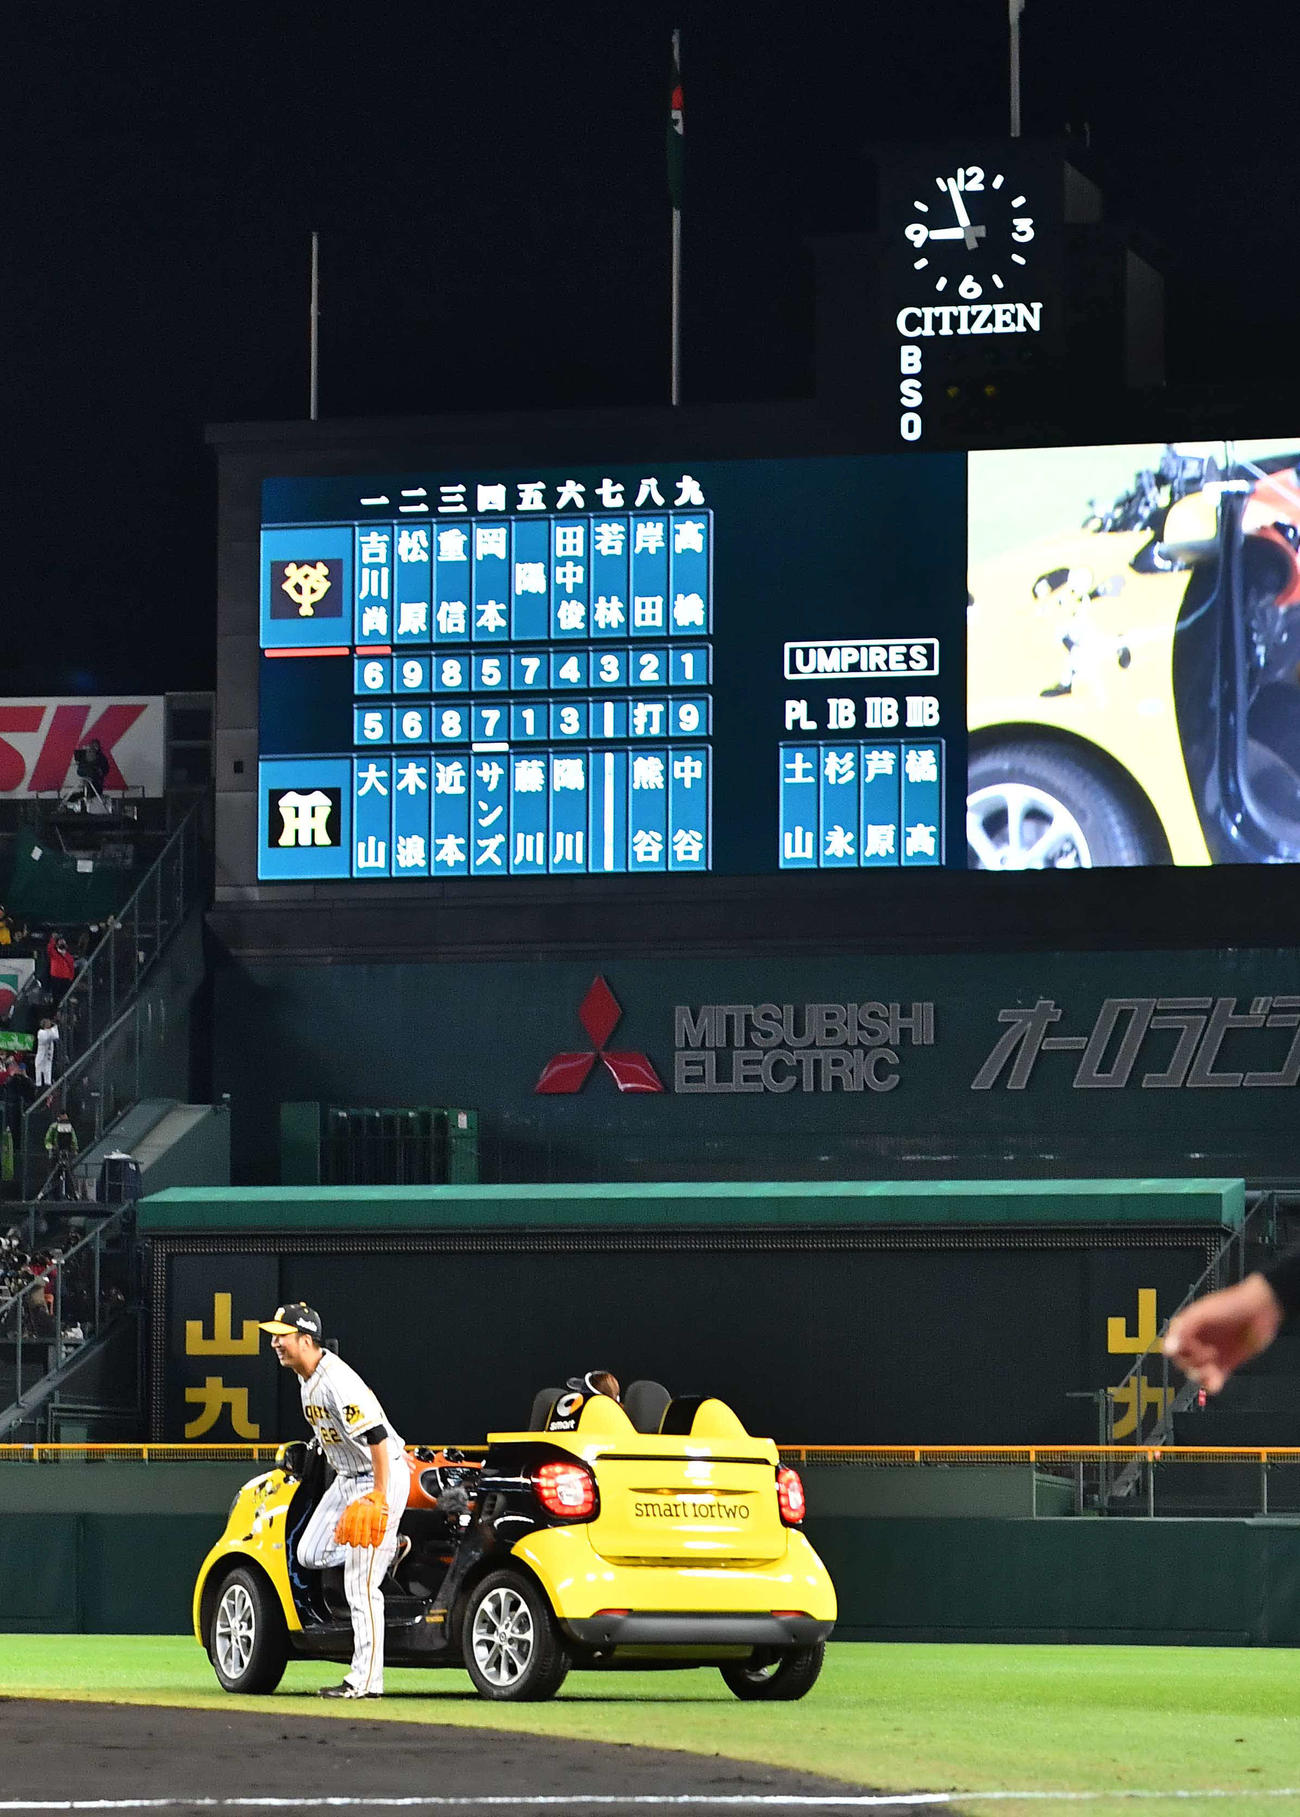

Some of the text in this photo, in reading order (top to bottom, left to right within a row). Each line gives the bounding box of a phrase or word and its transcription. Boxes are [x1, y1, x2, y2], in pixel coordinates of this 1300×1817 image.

[956, 166, 985, 192] 12
[1011, 217, 1035, 243] 3
[904, 223, 929, 248] 9
[958, 274, 983, 300] 6
[896, 302, 1043, 338] CITIZEN
[900, 345, 922, 375] B
[900, 378, 923, 408] S
[900, 412, 922, 441] O
[360, 475, 705, 513] 一 二 三 四 五 六 七 八 九
[359, 531, 390, 636] 吉川尚
[397, 529, 429, 635] 松原
[436, 528, 468, 633] 重信
[476, 527, 507, 632] 岡本
[515, 562, 546, 595] 陽
[555, 525, 585, 630] 田中俊
[594, 523, 625, 628] 若林
[634, 521, 665, 626] 岸田
[363, 653, 693, 689] 6 9 8 5 7 4 3 2 1
[795, 645, 928, 673] UMPIRES
[363, 702, 699, 740] 5 6 8 7 1 3 打 9
[785, 699, 818, 730] PL
[357, 763, 388, 868] 大山
[396, 762, 427, 868] 木浪
[435, 761, 466, 867] 近本
[475, 762, 505, 866] サンズ
[514, 759, 545, 865] 藤川
[553, 758, 585, 864] 陽川
[632, 756, 664, 860] 熊谷
[672, 755, 703, 858] 中谷
[784, 752, 815, 860] 土山
[824, 751, 855, 858] 杉永
[864, 750, 896, 857] 芦原
[905, 749, 938, 857] 橘高
[674, 1001, 935, 1048] MITSUBISHI
[674, 1047, 900, 1094] ELECTRIC
[185, 1292, 260, 1439] 山九
[549, 1419, 576, 1431] smart
[634, 1501, 688, 1518] smart
